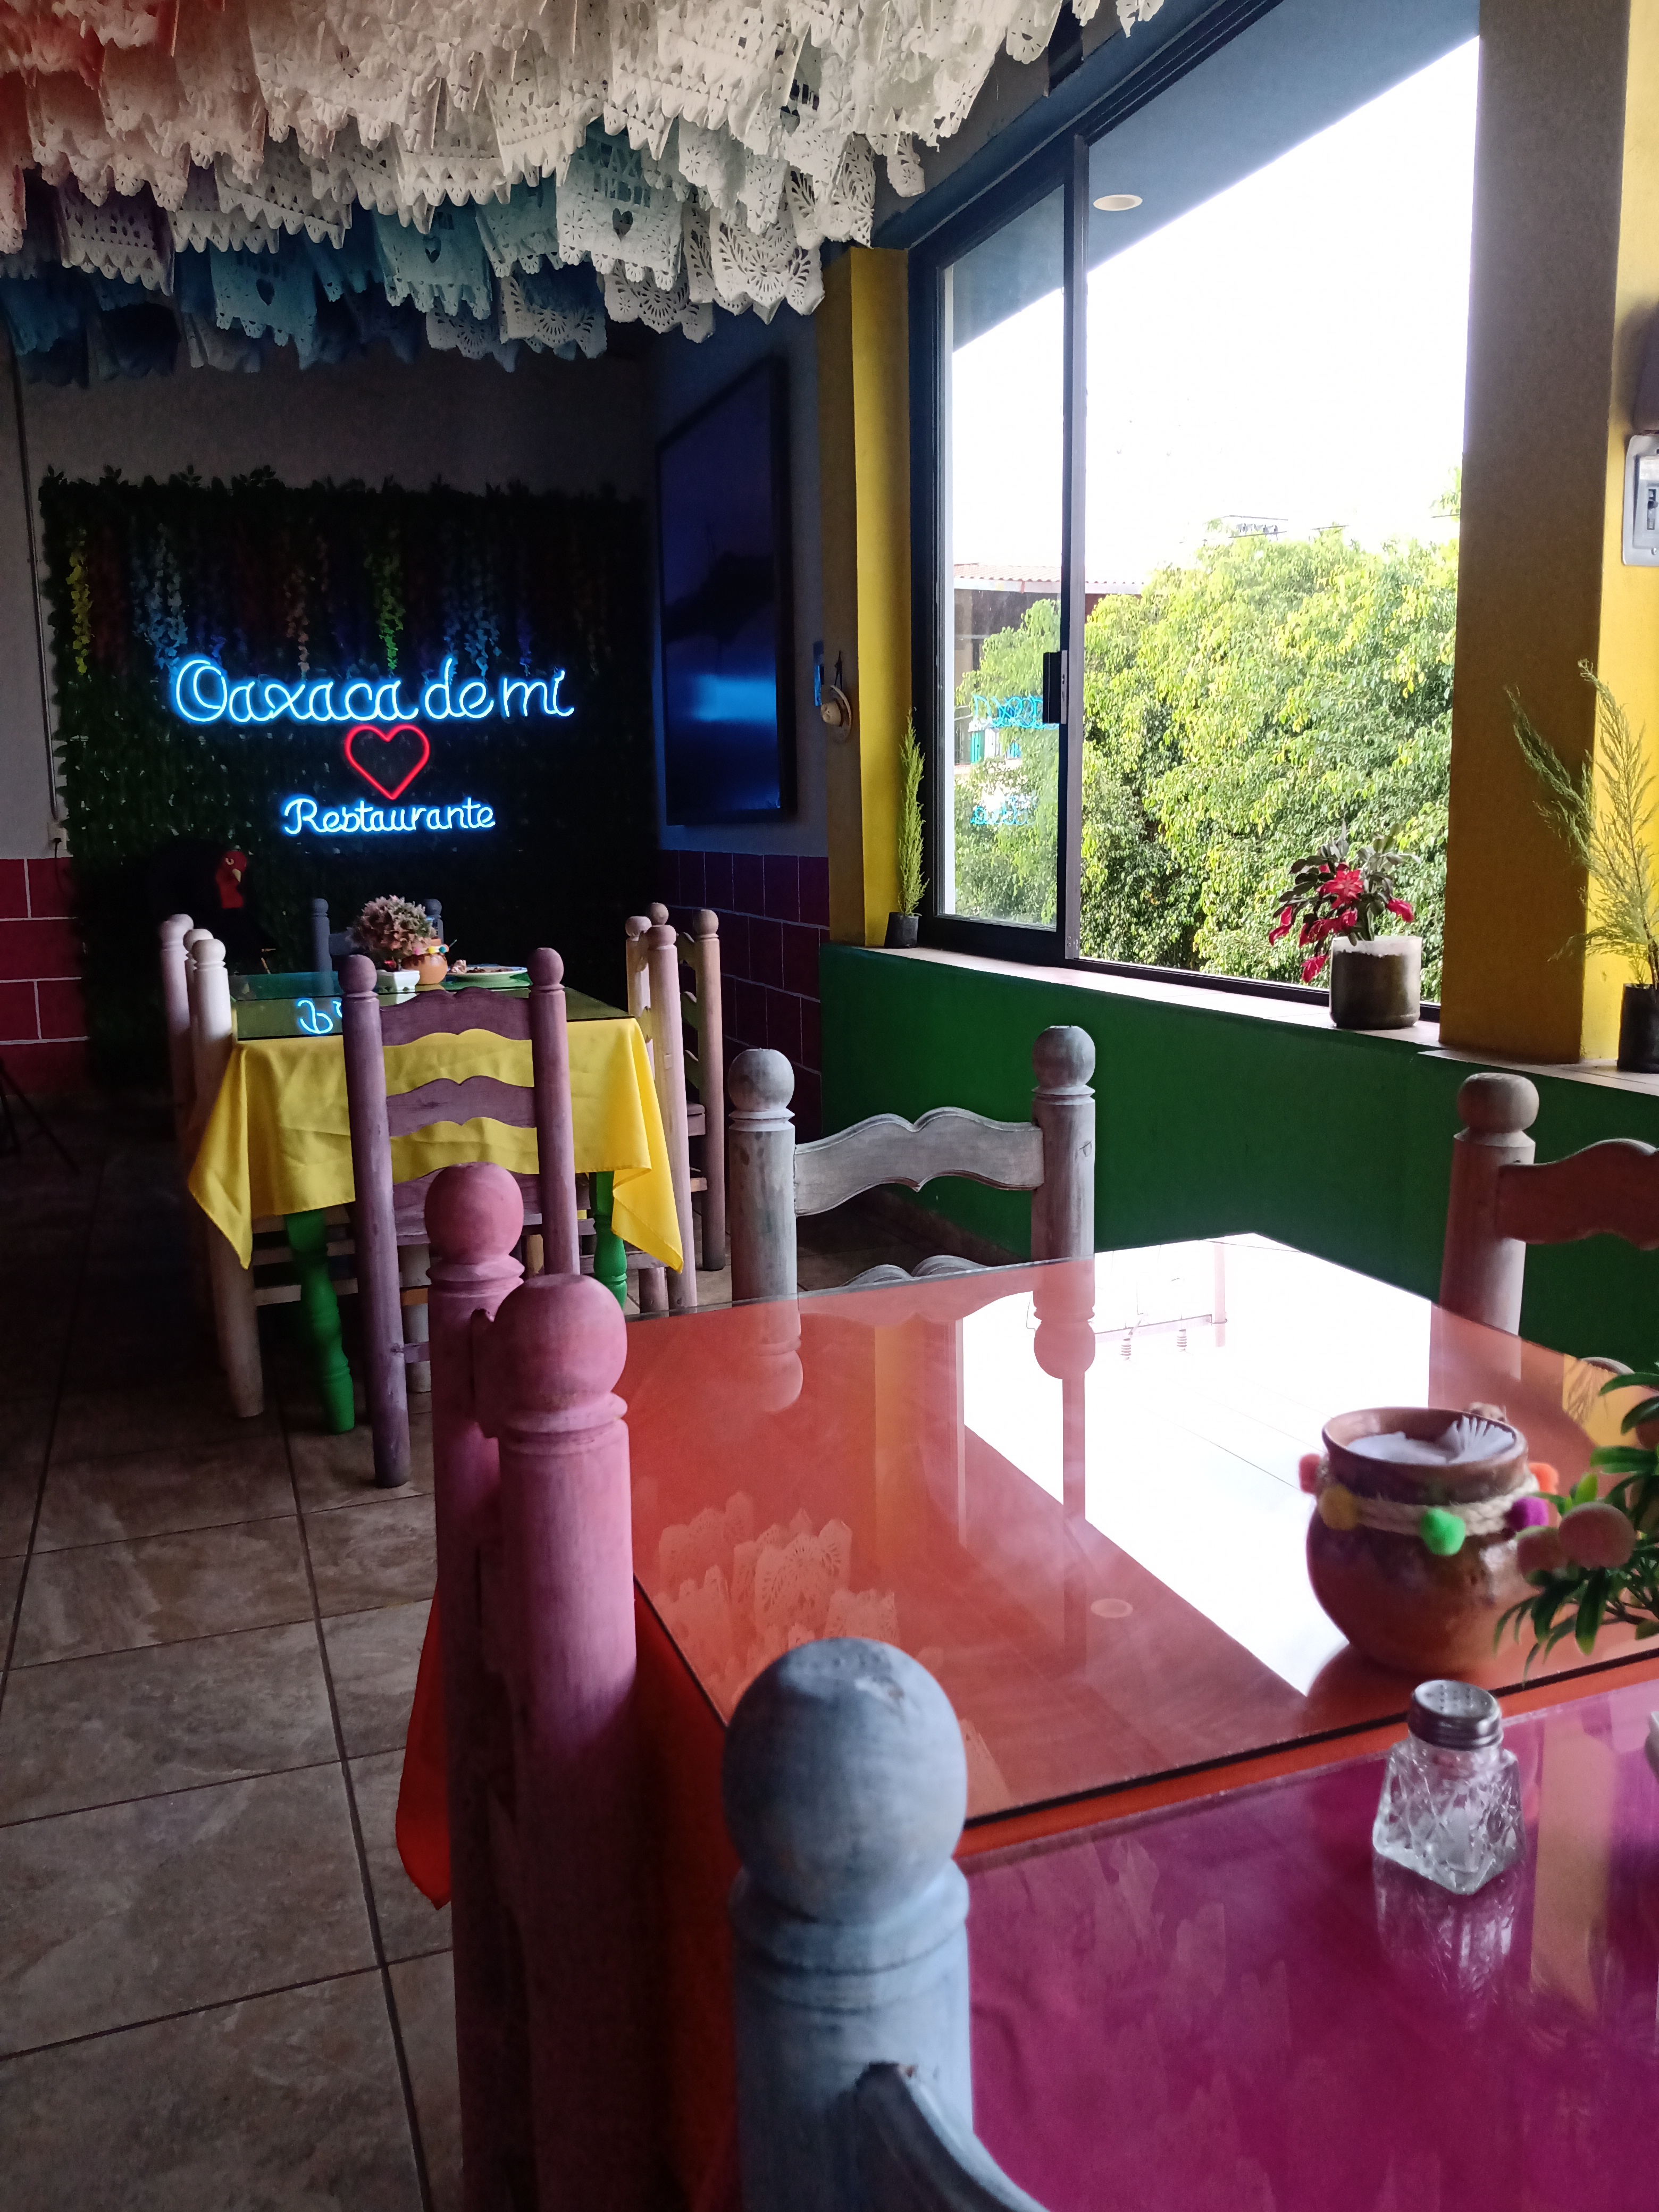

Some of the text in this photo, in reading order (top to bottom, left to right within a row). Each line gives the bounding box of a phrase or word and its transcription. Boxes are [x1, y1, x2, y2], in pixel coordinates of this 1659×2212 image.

[176, 658, 574, 722] Oaxaca de mi
[284, 798, 495, 834] Restaurante
